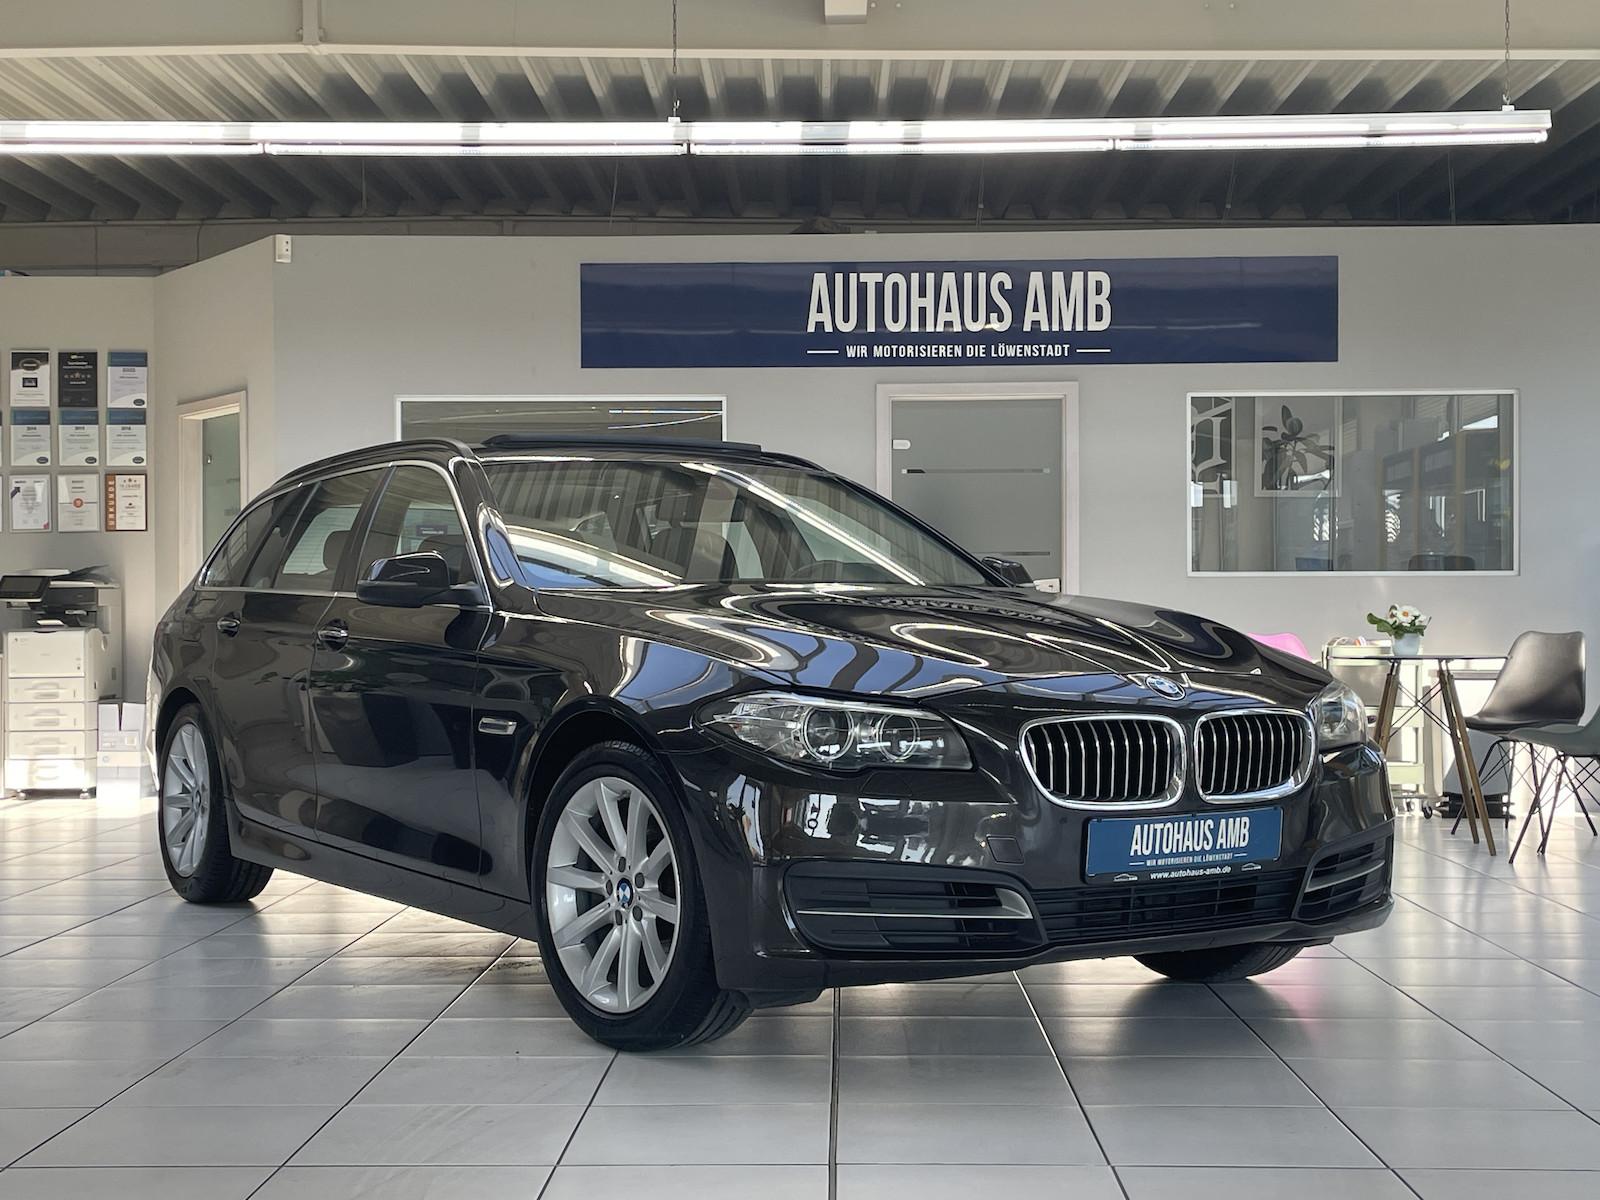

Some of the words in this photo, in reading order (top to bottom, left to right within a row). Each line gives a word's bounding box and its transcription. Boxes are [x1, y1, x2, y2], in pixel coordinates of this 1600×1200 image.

[806, 272, 1013, 333] AUTOHAUS
[1022, 271, 1112, 332] AMB
[846, 345, 868, 358] WIR
[873, 345, 963, 358] MOTORISIEREN
[966, 344, 986, 357] DIE
[991, 342, 1070, 357] LÖWENSTADT
[1130, 819, 1214, 856] AUTOHAUS
[1216, 816, 1250, 850] AMB
[1150, 865, 1232, 879] www.autohaus-amb.de
